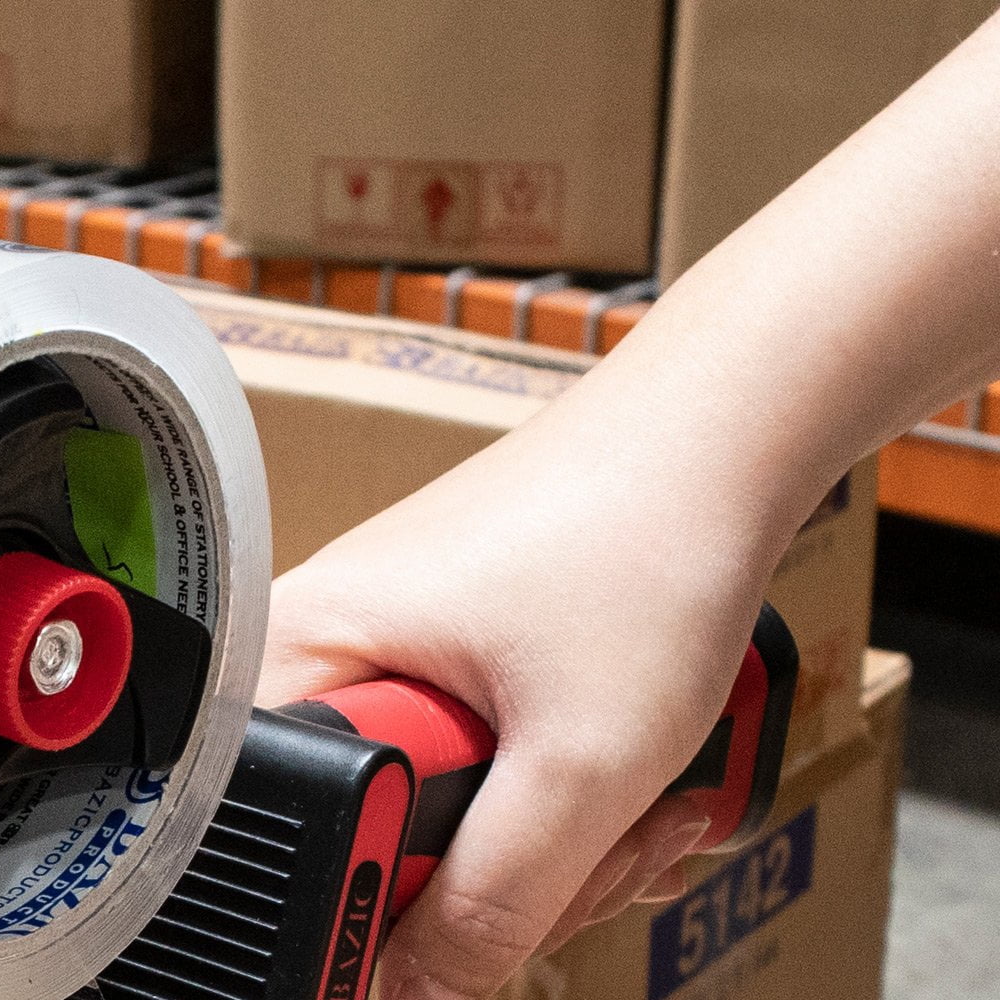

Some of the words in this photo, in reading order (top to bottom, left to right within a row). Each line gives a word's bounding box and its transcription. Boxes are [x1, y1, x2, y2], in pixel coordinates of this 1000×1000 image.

[161, 414, 182, 445] WIDE
[157, 444, 181, 500] SCHOOL
[177, 449, 199, 499] RANGE
[173, 503, 187, 516] &
[192, 500, 204, 519] OF
[175, 518, 189, 577] OFFICE
[195, 525, 207, 623] STATIONERY
[17, 779, 51, 824] GREAT
